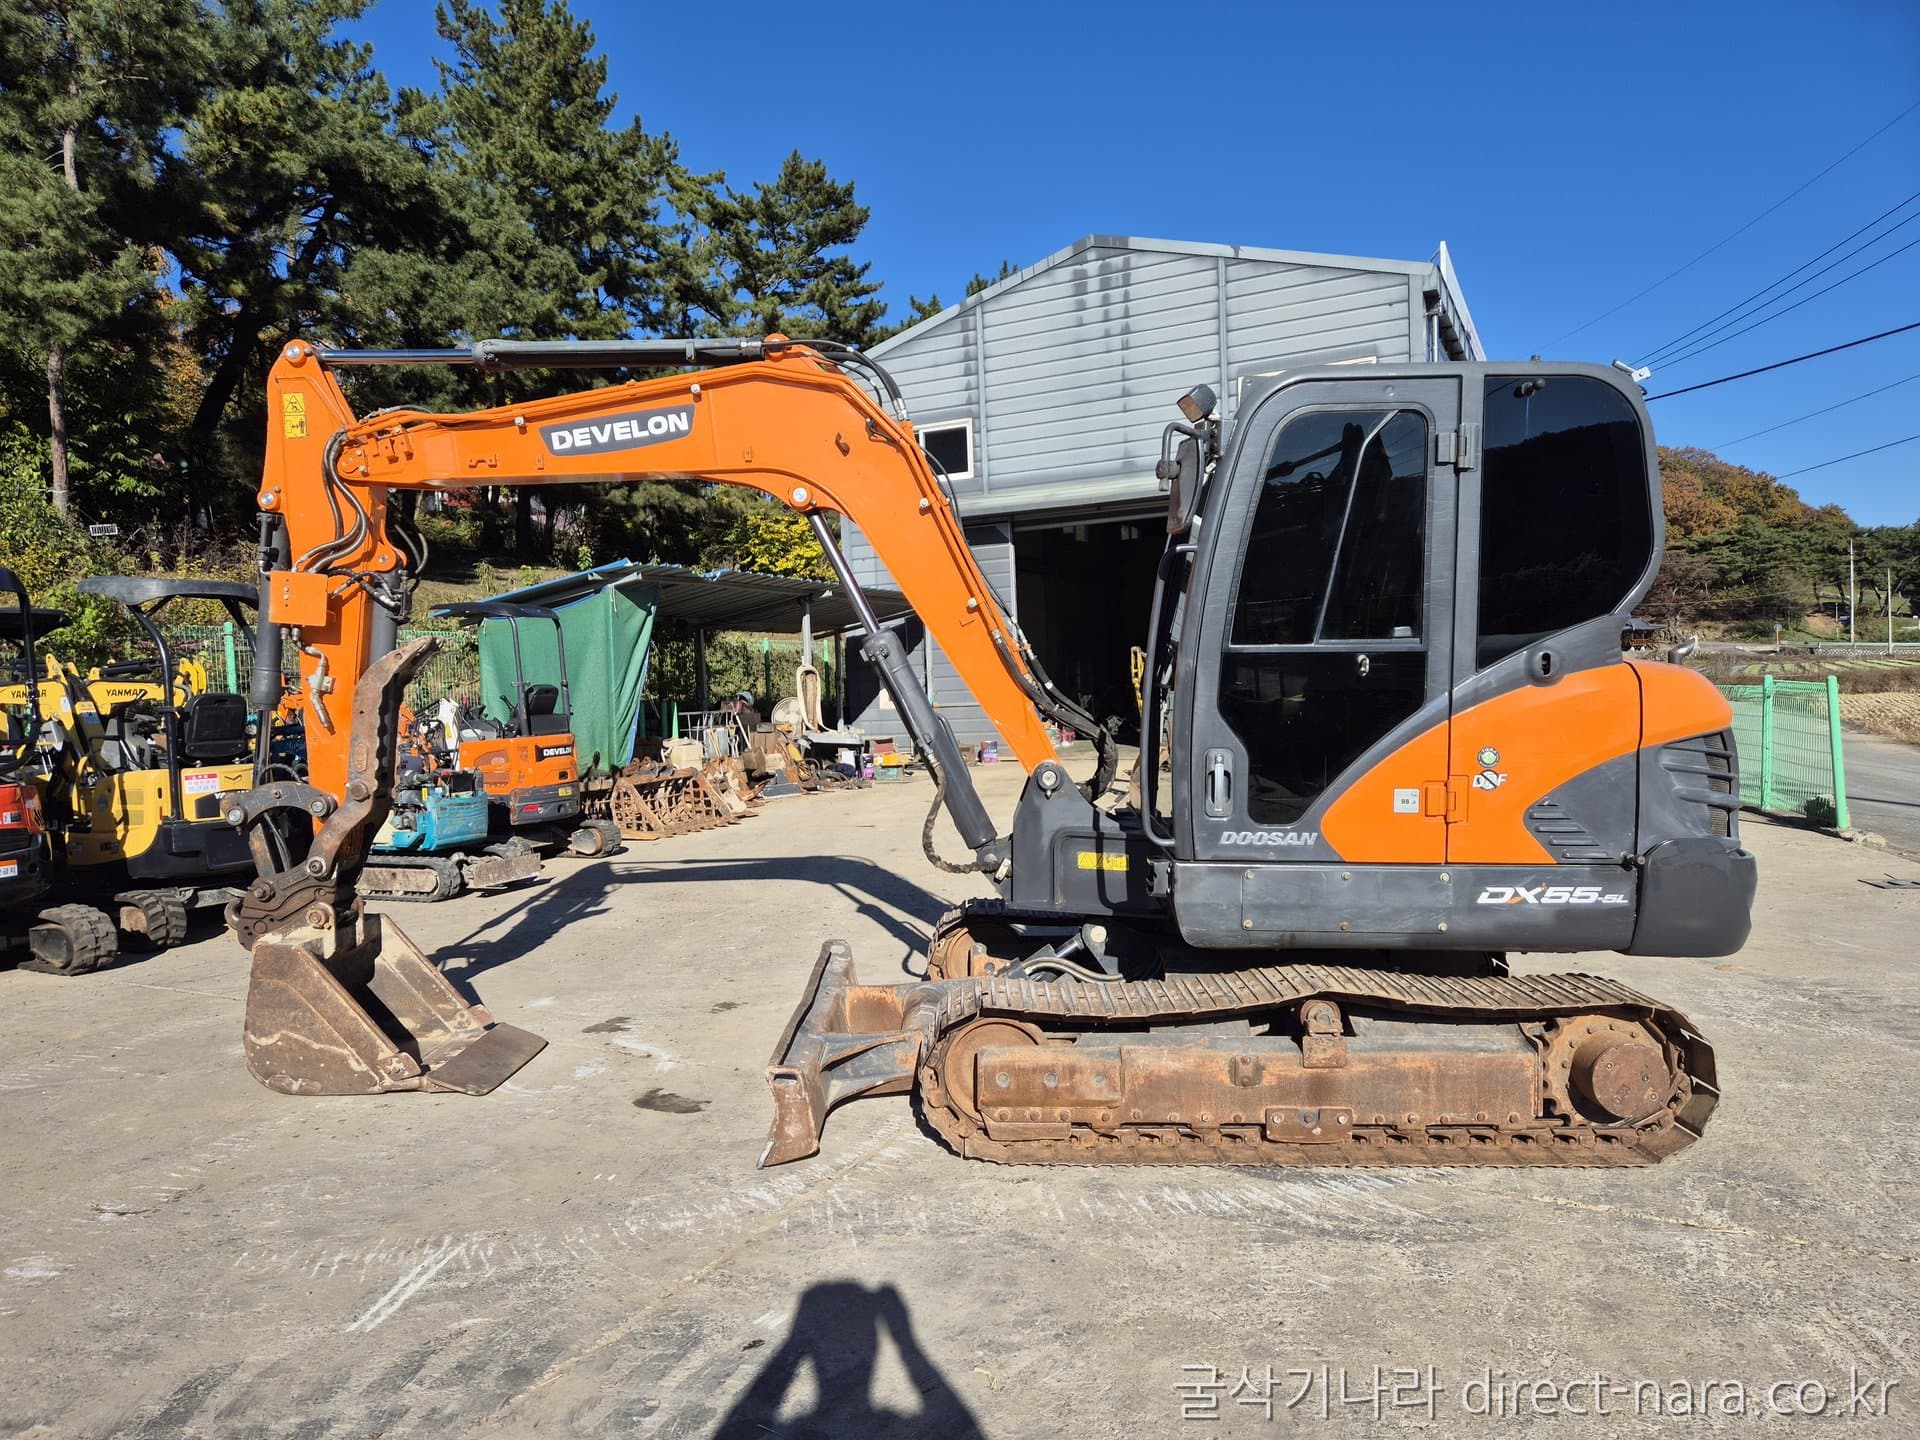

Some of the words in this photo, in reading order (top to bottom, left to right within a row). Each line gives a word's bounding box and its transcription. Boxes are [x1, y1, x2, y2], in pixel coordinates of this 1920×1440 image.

[551, 412, 689, 450] DEVELON
[11, 689, 47, 698] YANR
[1219, 831, 1318, 846] DOOSAN
